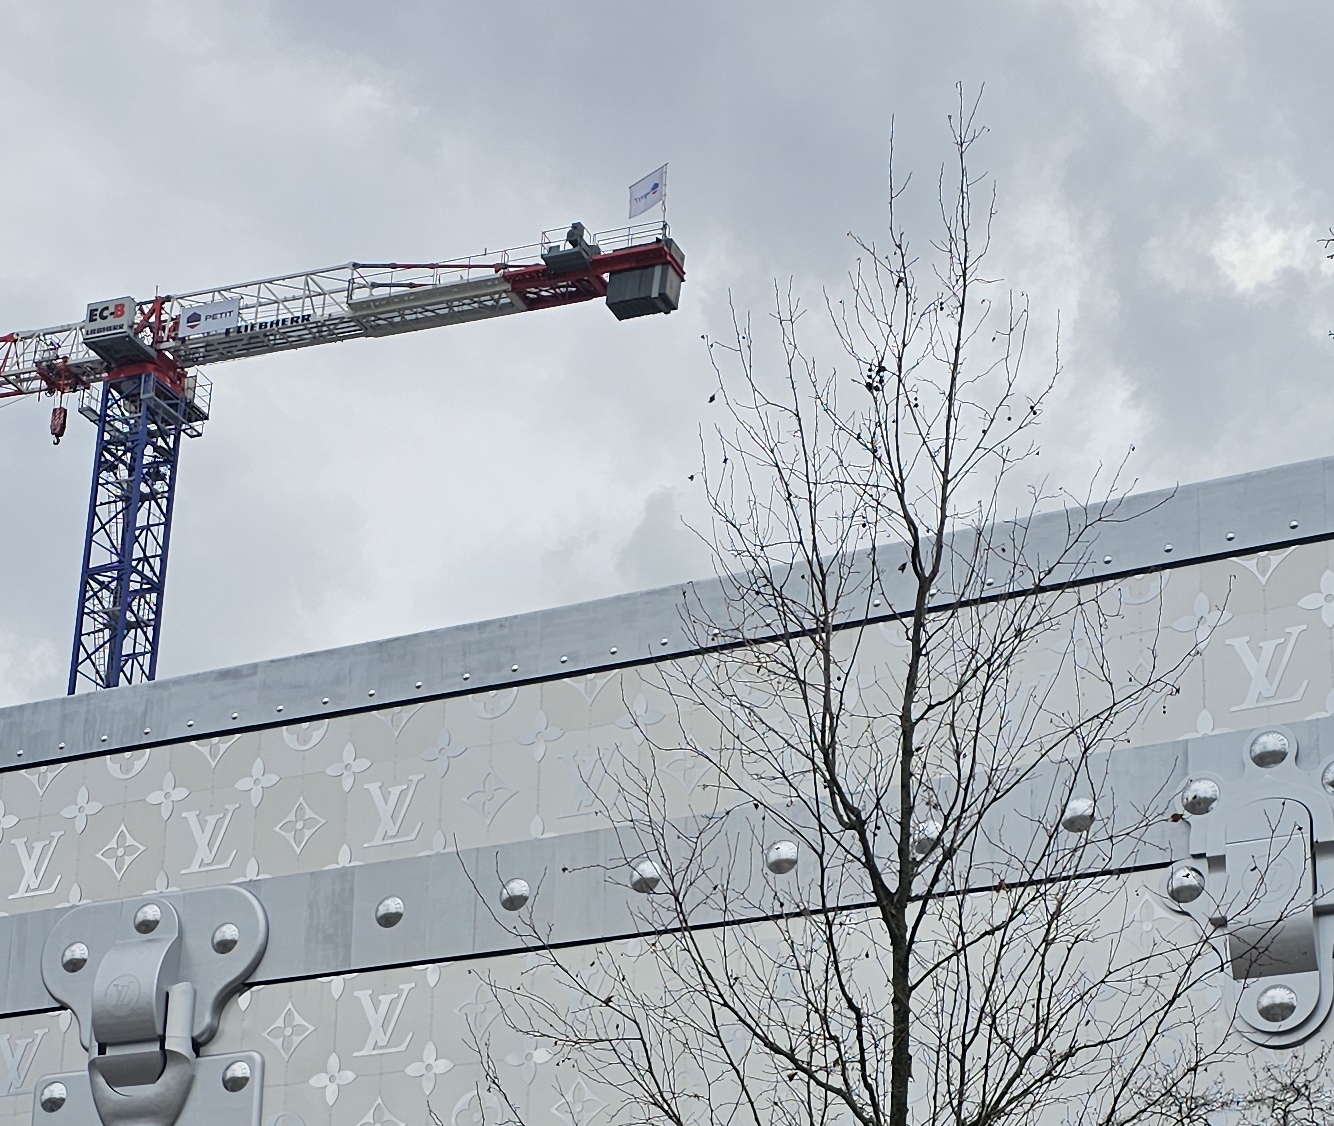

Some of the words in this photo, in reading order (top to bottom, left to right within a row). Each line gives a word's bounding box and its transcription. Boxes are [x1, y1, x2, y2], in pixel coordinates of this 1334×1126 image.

[88, 303, 125, 323] EC-B
[204, 309, 234, 322] PETIT
[85, 323, 124, 336] LIEBHERR
[237, 313, 312, 334] LIEBHERR
